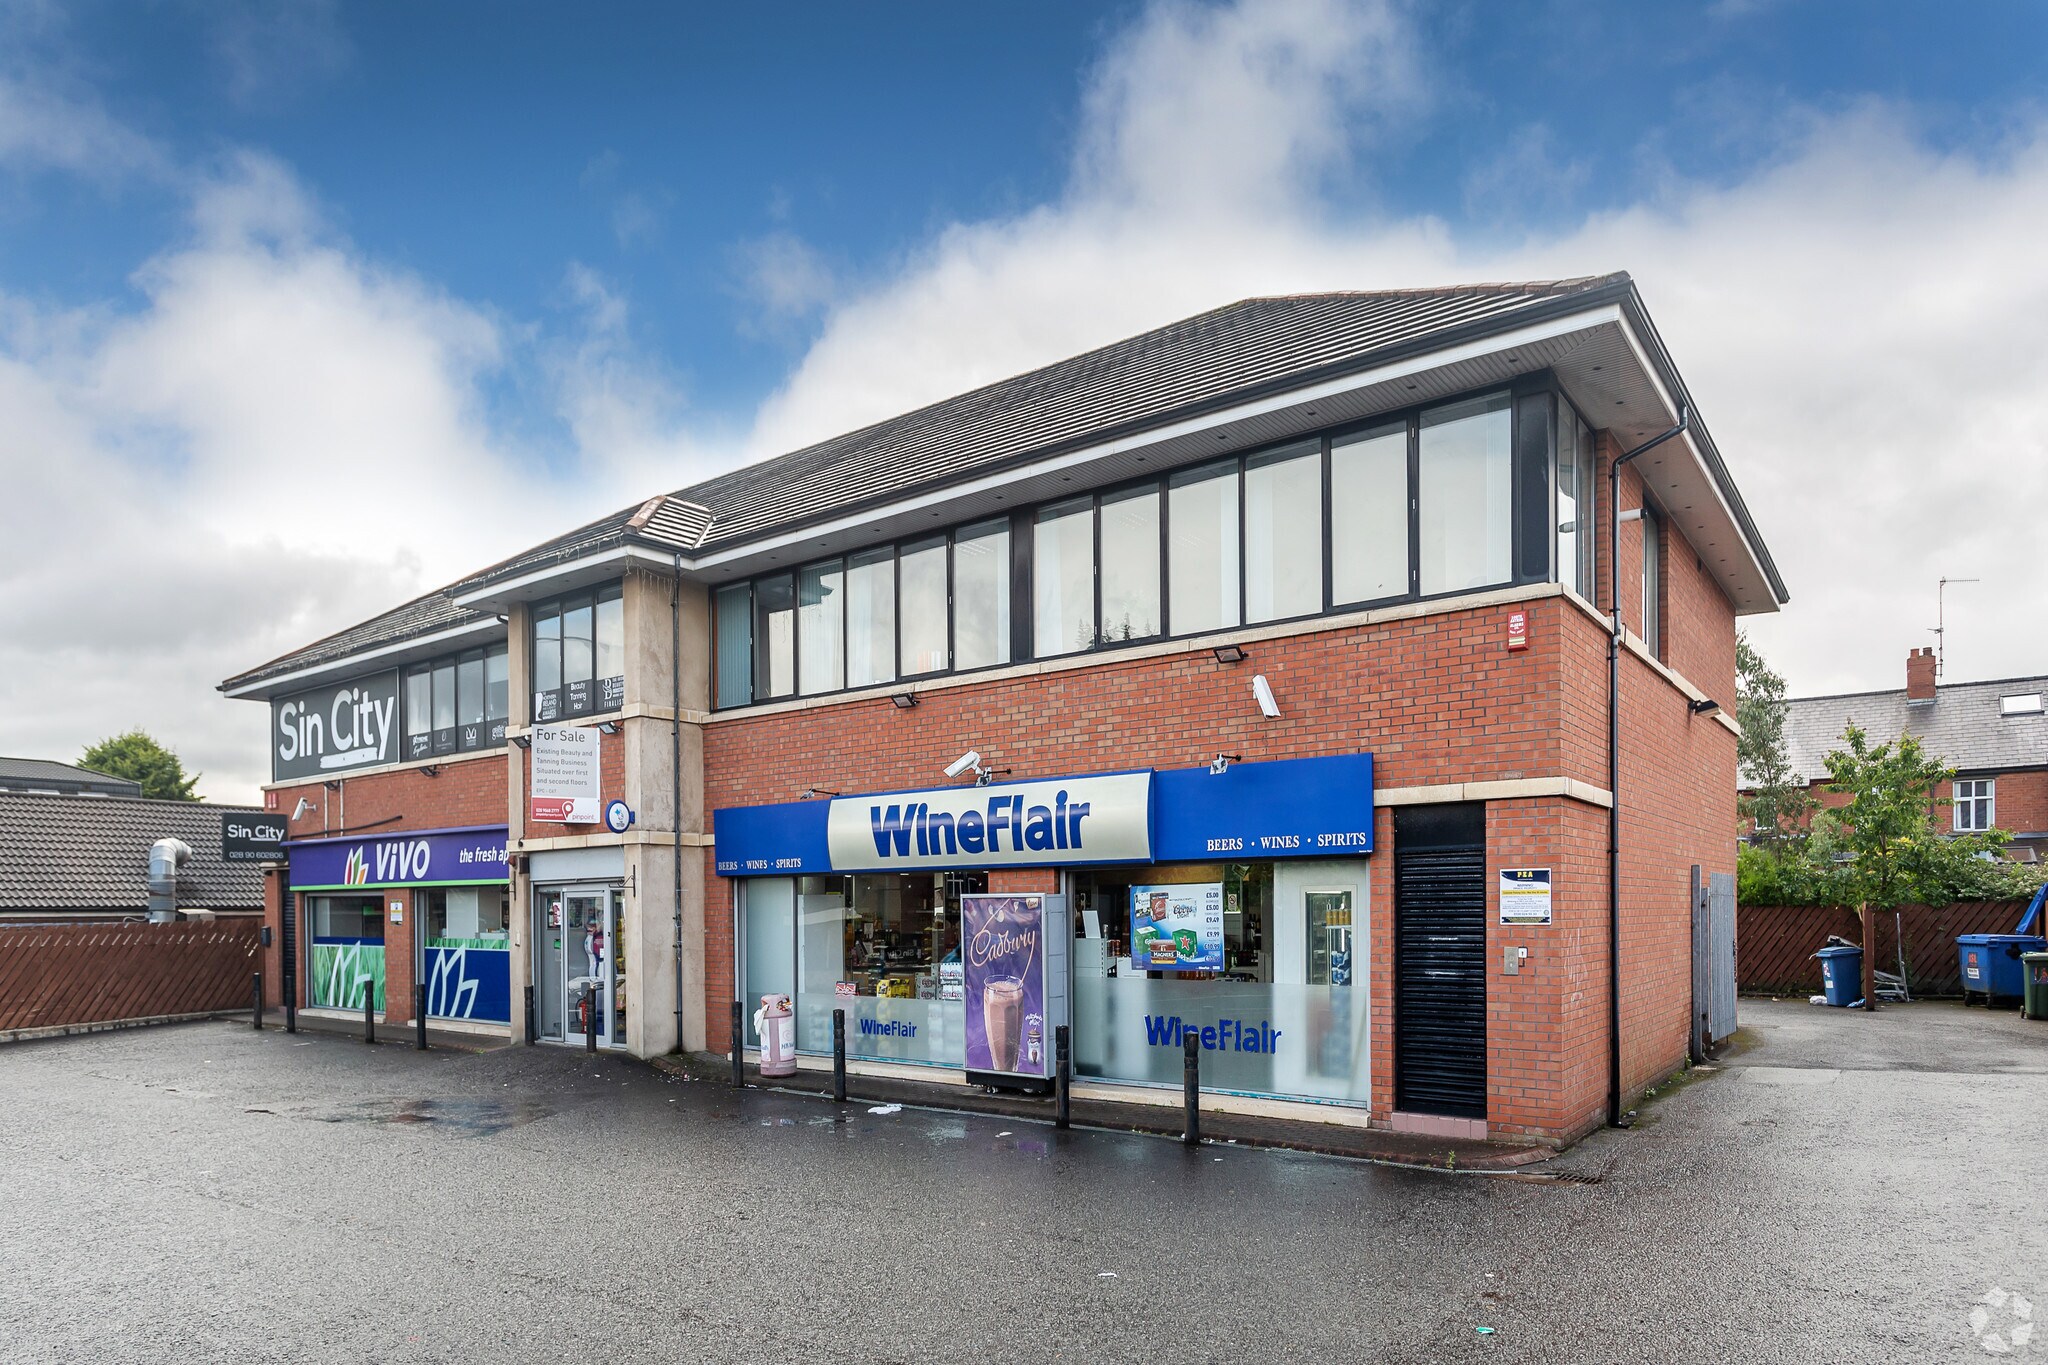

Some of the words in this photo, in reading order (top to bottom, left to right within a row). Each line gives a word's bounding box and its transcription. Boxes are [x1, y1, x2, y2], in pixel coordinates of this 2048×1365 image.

[570, 682, 586, 691] Beauty
[570, 691, 587, 701] Tanning
[573, 702, 583, 710] Hair
[279, 701, 324, 761] Sin
[331, 687, 394, 761] City
[536, 728, 557, 741] For
[560, 730, 585, 742] Sale
[536, 747, 560, 756] Existing
[560, 749, 581, 757] Beauty
[536, 757, 560, 766] Tanning
[870, 789, 1091, 858] WineFlair
[227, 824, 252, 838] Sin
[255, 825, 285, 842] City
[1206, 838, 1243, 851] BEERS
[1260, 835, 1300, 849] WINES
[1317, 832, 1366, 847] SPIRITS
[459, 848, 473, 863] the
[475, 846, 497, 862] fresh
[718, 861, 738, 870] BEERS
[746, 860, 768, 869] WINES
[775, 857, 801, 868] SPIRITS
[860, 1018, 918, 1038] WineFlair
